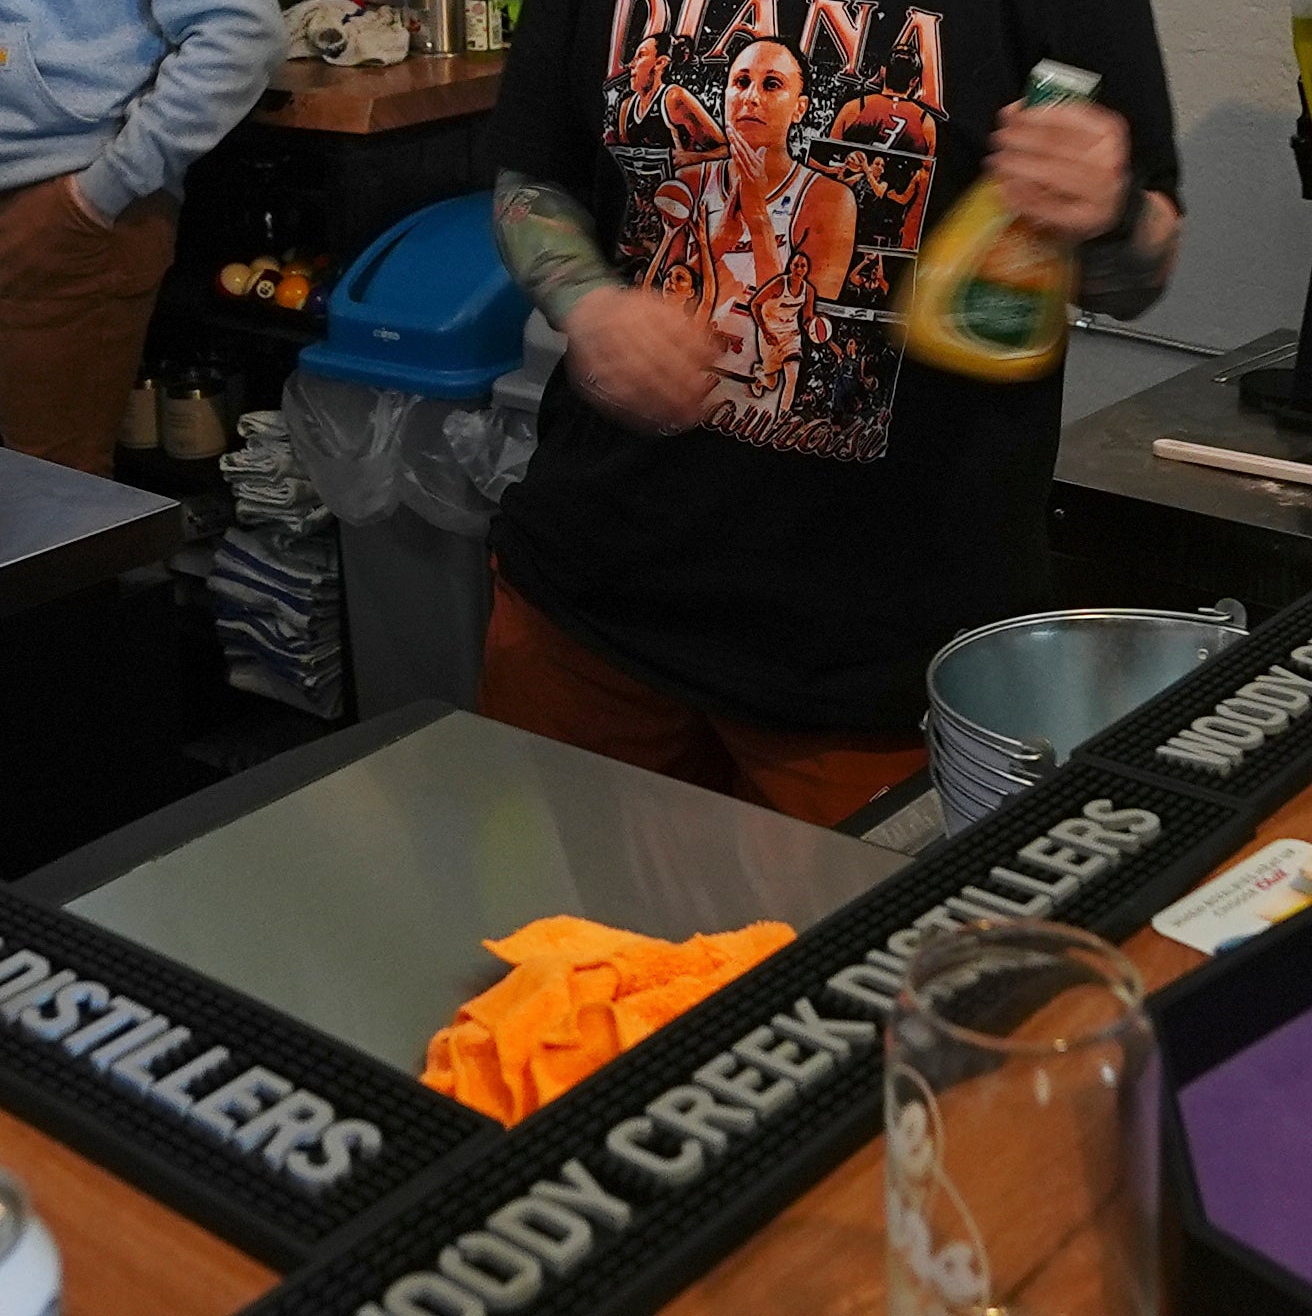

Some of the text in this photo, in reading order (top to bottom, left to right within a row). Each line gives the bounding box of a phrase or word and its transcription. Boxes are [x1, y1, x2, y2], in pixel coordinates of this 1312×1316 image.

[873, 115, 906, 150] 3
[704, 392, 892, 465] aurasi
[353, 1156, 633, 1316] OODY
[605, 997, 876, 1189] CREEK
[825, 797, 1164, 1014] DISTILLERS
